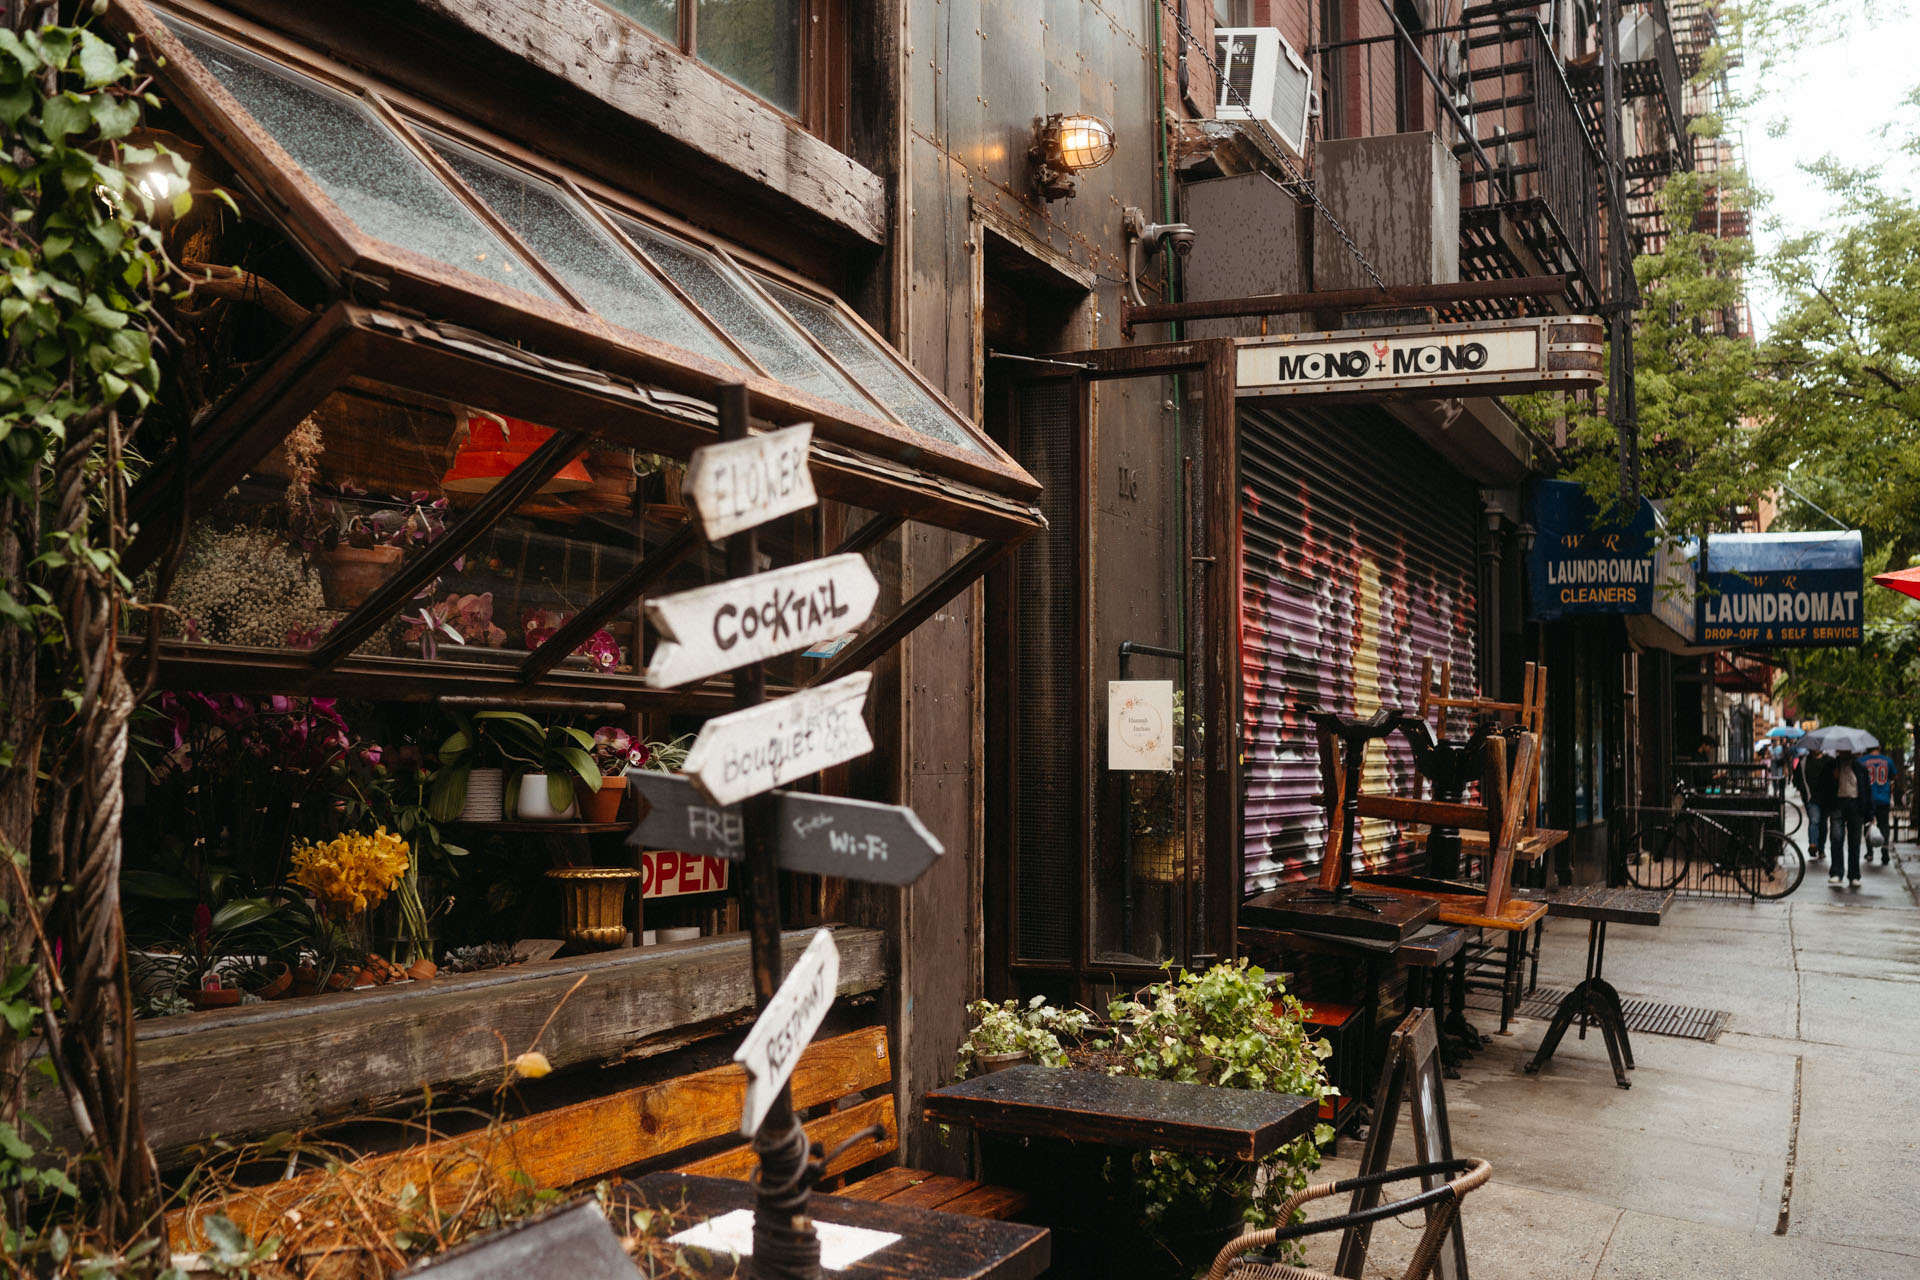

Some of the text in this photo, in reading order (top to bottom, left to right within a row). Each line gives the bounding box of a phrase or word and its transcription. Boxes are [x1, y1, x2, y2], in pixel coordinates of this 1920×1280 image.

[1279, 350, 1371, 381] MONO
[1393, 342, 1489, 374] MONO
[1561, 534, 1623, 553] W R
[1548, 559, 1652, 584] LAUNDROMAT
[1782, 576, 1798, 590] R
[1560, 587, 1637, 604] CLEANERS
[713, 578, 849, 651] COCKTAIL
[1705, 591, 1858, 623] LAUNDROMAT
[1705, 627, 1860, 640] DROP-OFF & SELF SERVICE
